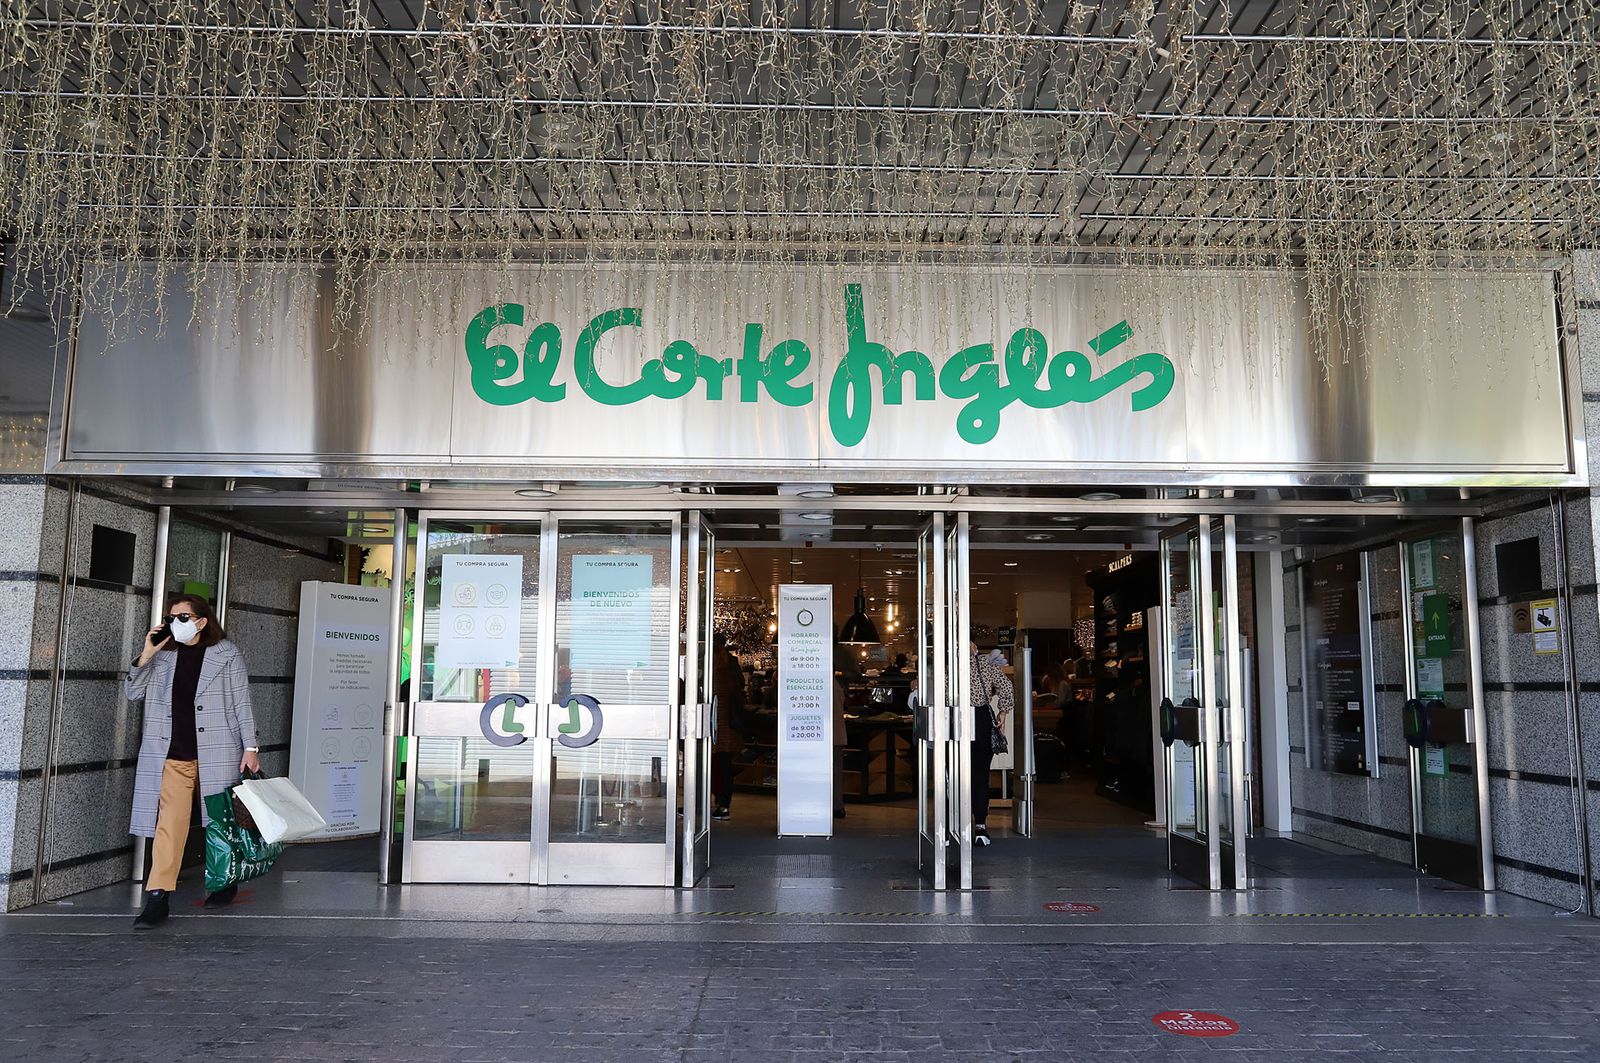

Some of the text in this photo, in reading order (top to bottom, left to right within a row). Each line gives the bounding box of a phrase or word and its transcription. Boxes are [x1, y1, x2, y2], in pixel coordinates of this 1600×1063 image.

[465, 284, 1176, 448] El Corte Inglés
[1108, 554, 1132, 573] SCALPERS
[325, 631, 380, 642] BIENVENIDOS
[1178, 1012, 1197, 1021] 2
[1160, 1019, 1229, 1027] Metros
